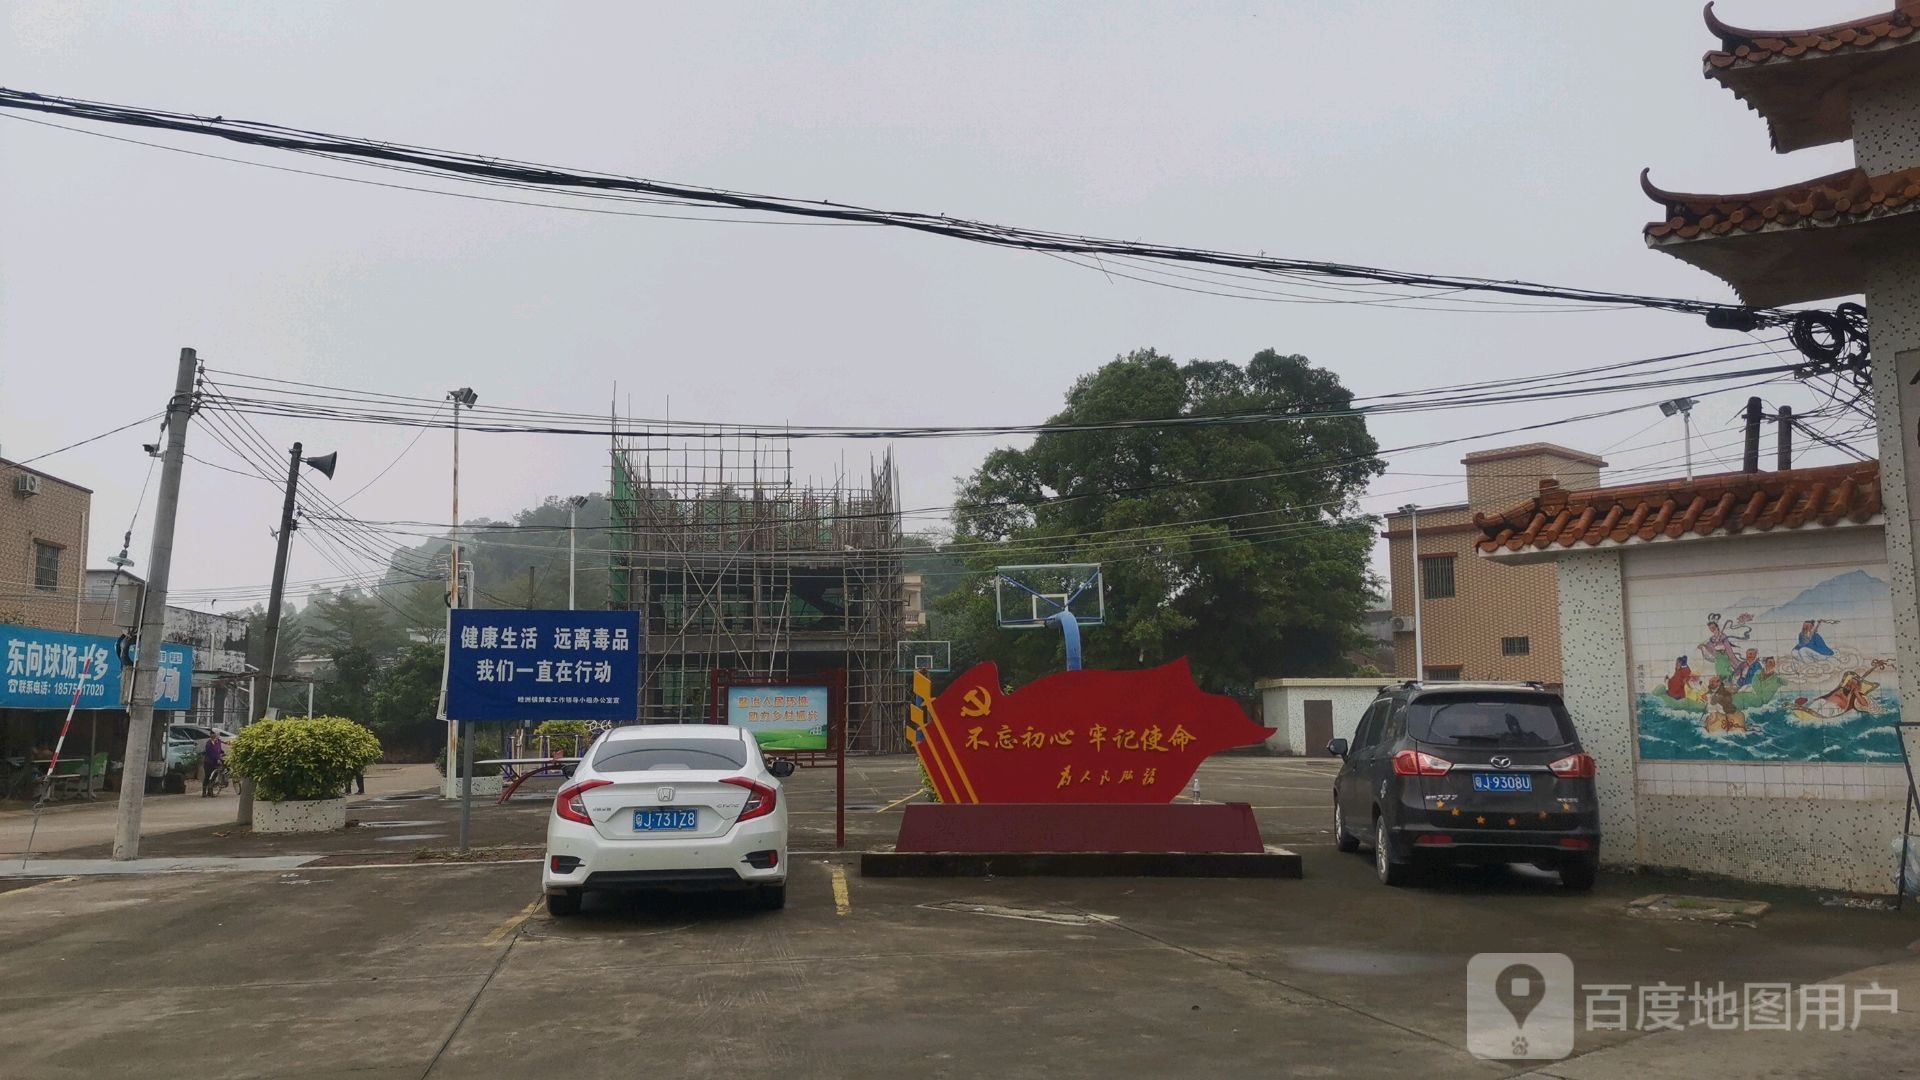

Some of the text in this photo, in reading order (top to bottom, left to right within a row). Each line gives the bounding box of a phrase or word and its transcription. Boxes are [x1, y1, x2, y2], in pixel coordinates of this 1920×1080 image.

[461, 625, 629, 651] 健康生活 远离毒品
[476, 658, 612, 683] 我们一直在行动
[965, 723, 1198, 752] 不忘初心 牢记使命
